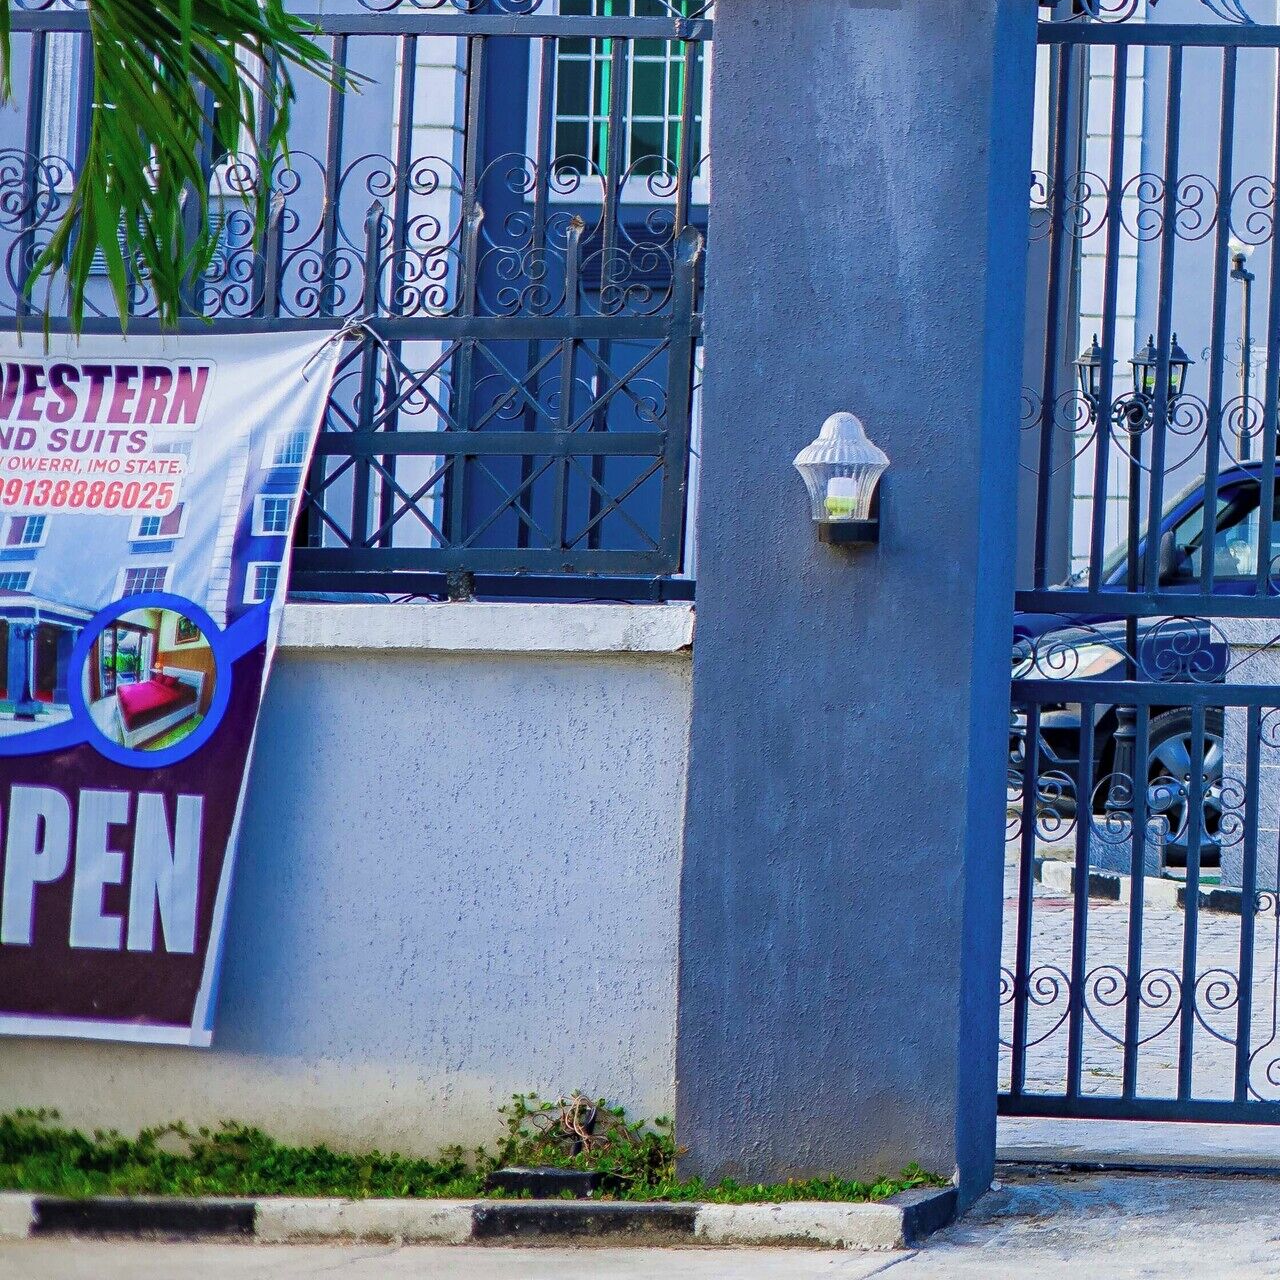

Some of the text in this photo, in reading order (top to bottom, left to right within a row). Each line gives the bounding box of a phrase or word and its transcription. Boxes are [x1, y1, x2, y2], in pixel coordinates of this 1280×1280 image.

[47, 428, 148, 454] SUITS
[7, 456, 82, 475] OWERRI,
[87, 459, 120, 473] IMO
[124, 460, 182, 474] STATE.
[0, 477, 175, 510] 9138886025
[1, 783, 203, 954] PEN
